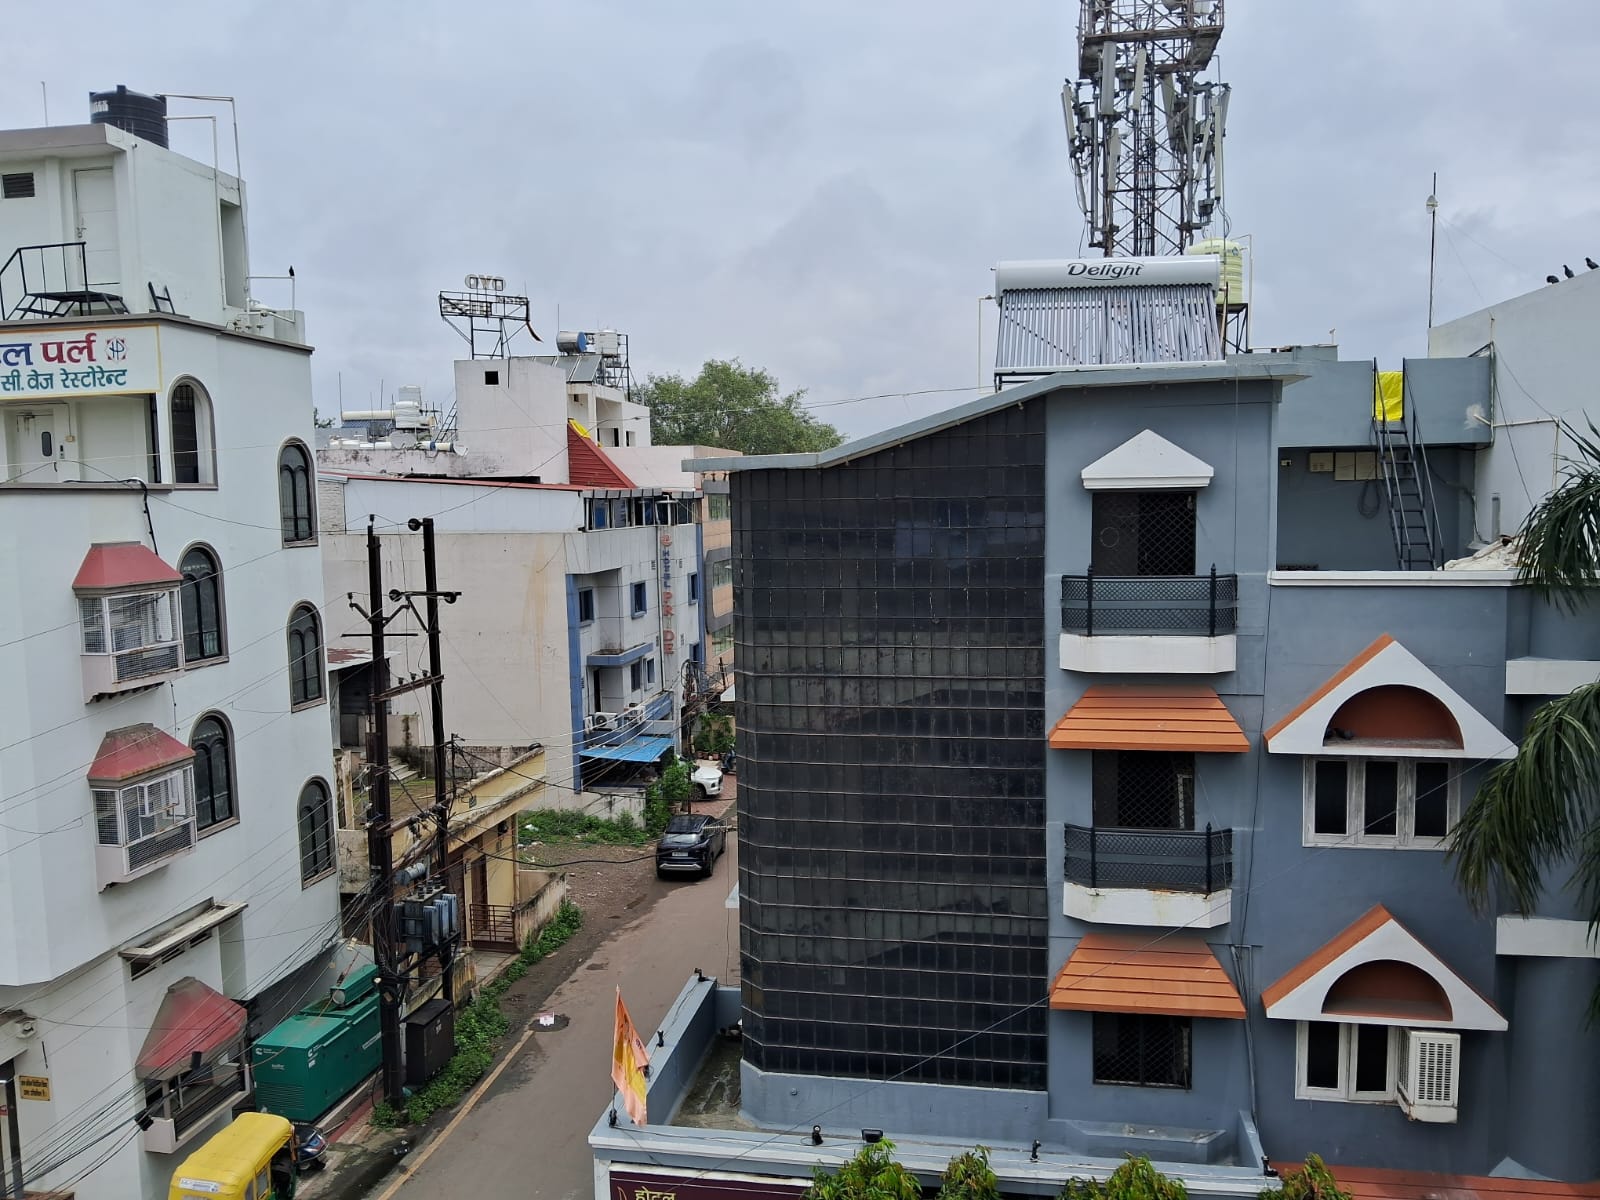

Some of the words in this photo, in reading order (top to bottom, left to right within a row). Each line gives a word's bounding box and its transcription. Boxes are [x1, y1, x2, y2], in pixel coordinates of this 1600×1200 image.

[1067, 263, 1143, 279] Delight
[0, 342, 33, 366] ल
[40, 332, 97, 364] पर्ल
[27, 369, 54, 391] वेज
